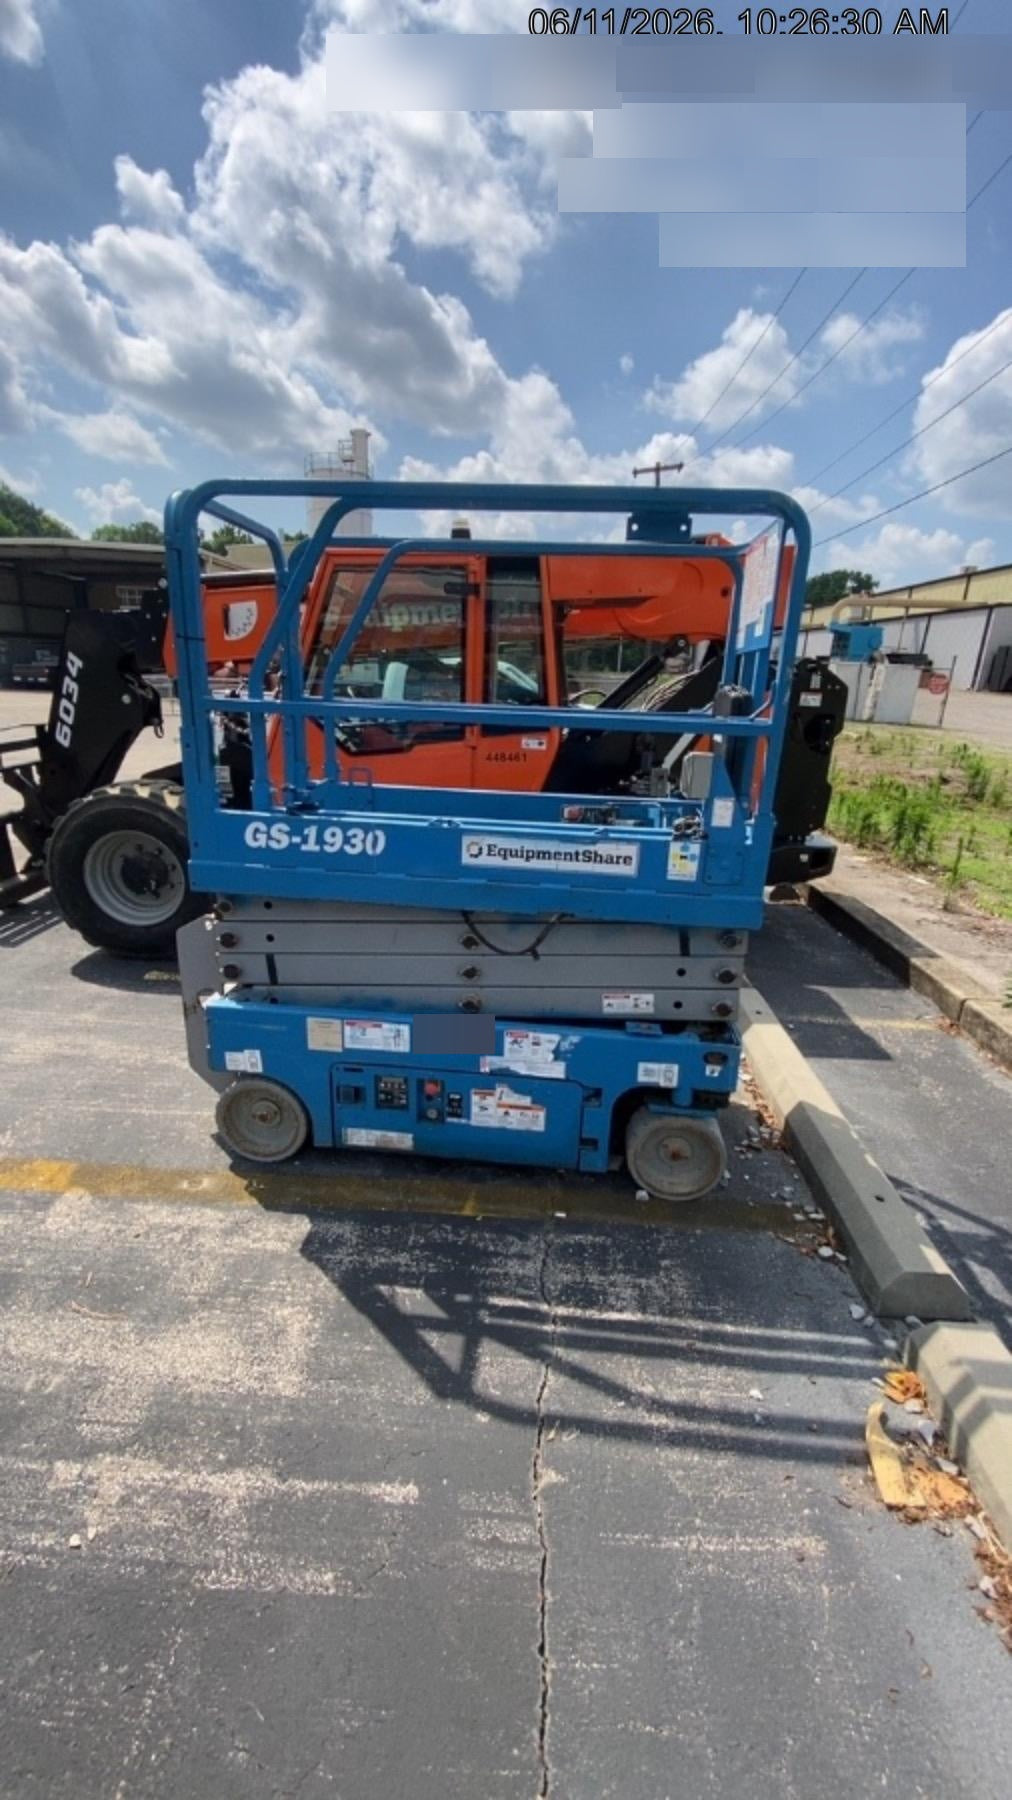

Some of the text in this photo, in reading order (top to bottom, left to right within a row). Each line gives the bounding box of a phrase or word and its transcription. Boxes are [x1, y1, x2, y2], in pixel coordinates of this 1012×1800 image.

[54, 650, 84, 749] 6034
[244, 821, 386, 856] GS-1930
[486, 843, 633, 867] EquipmentShare
